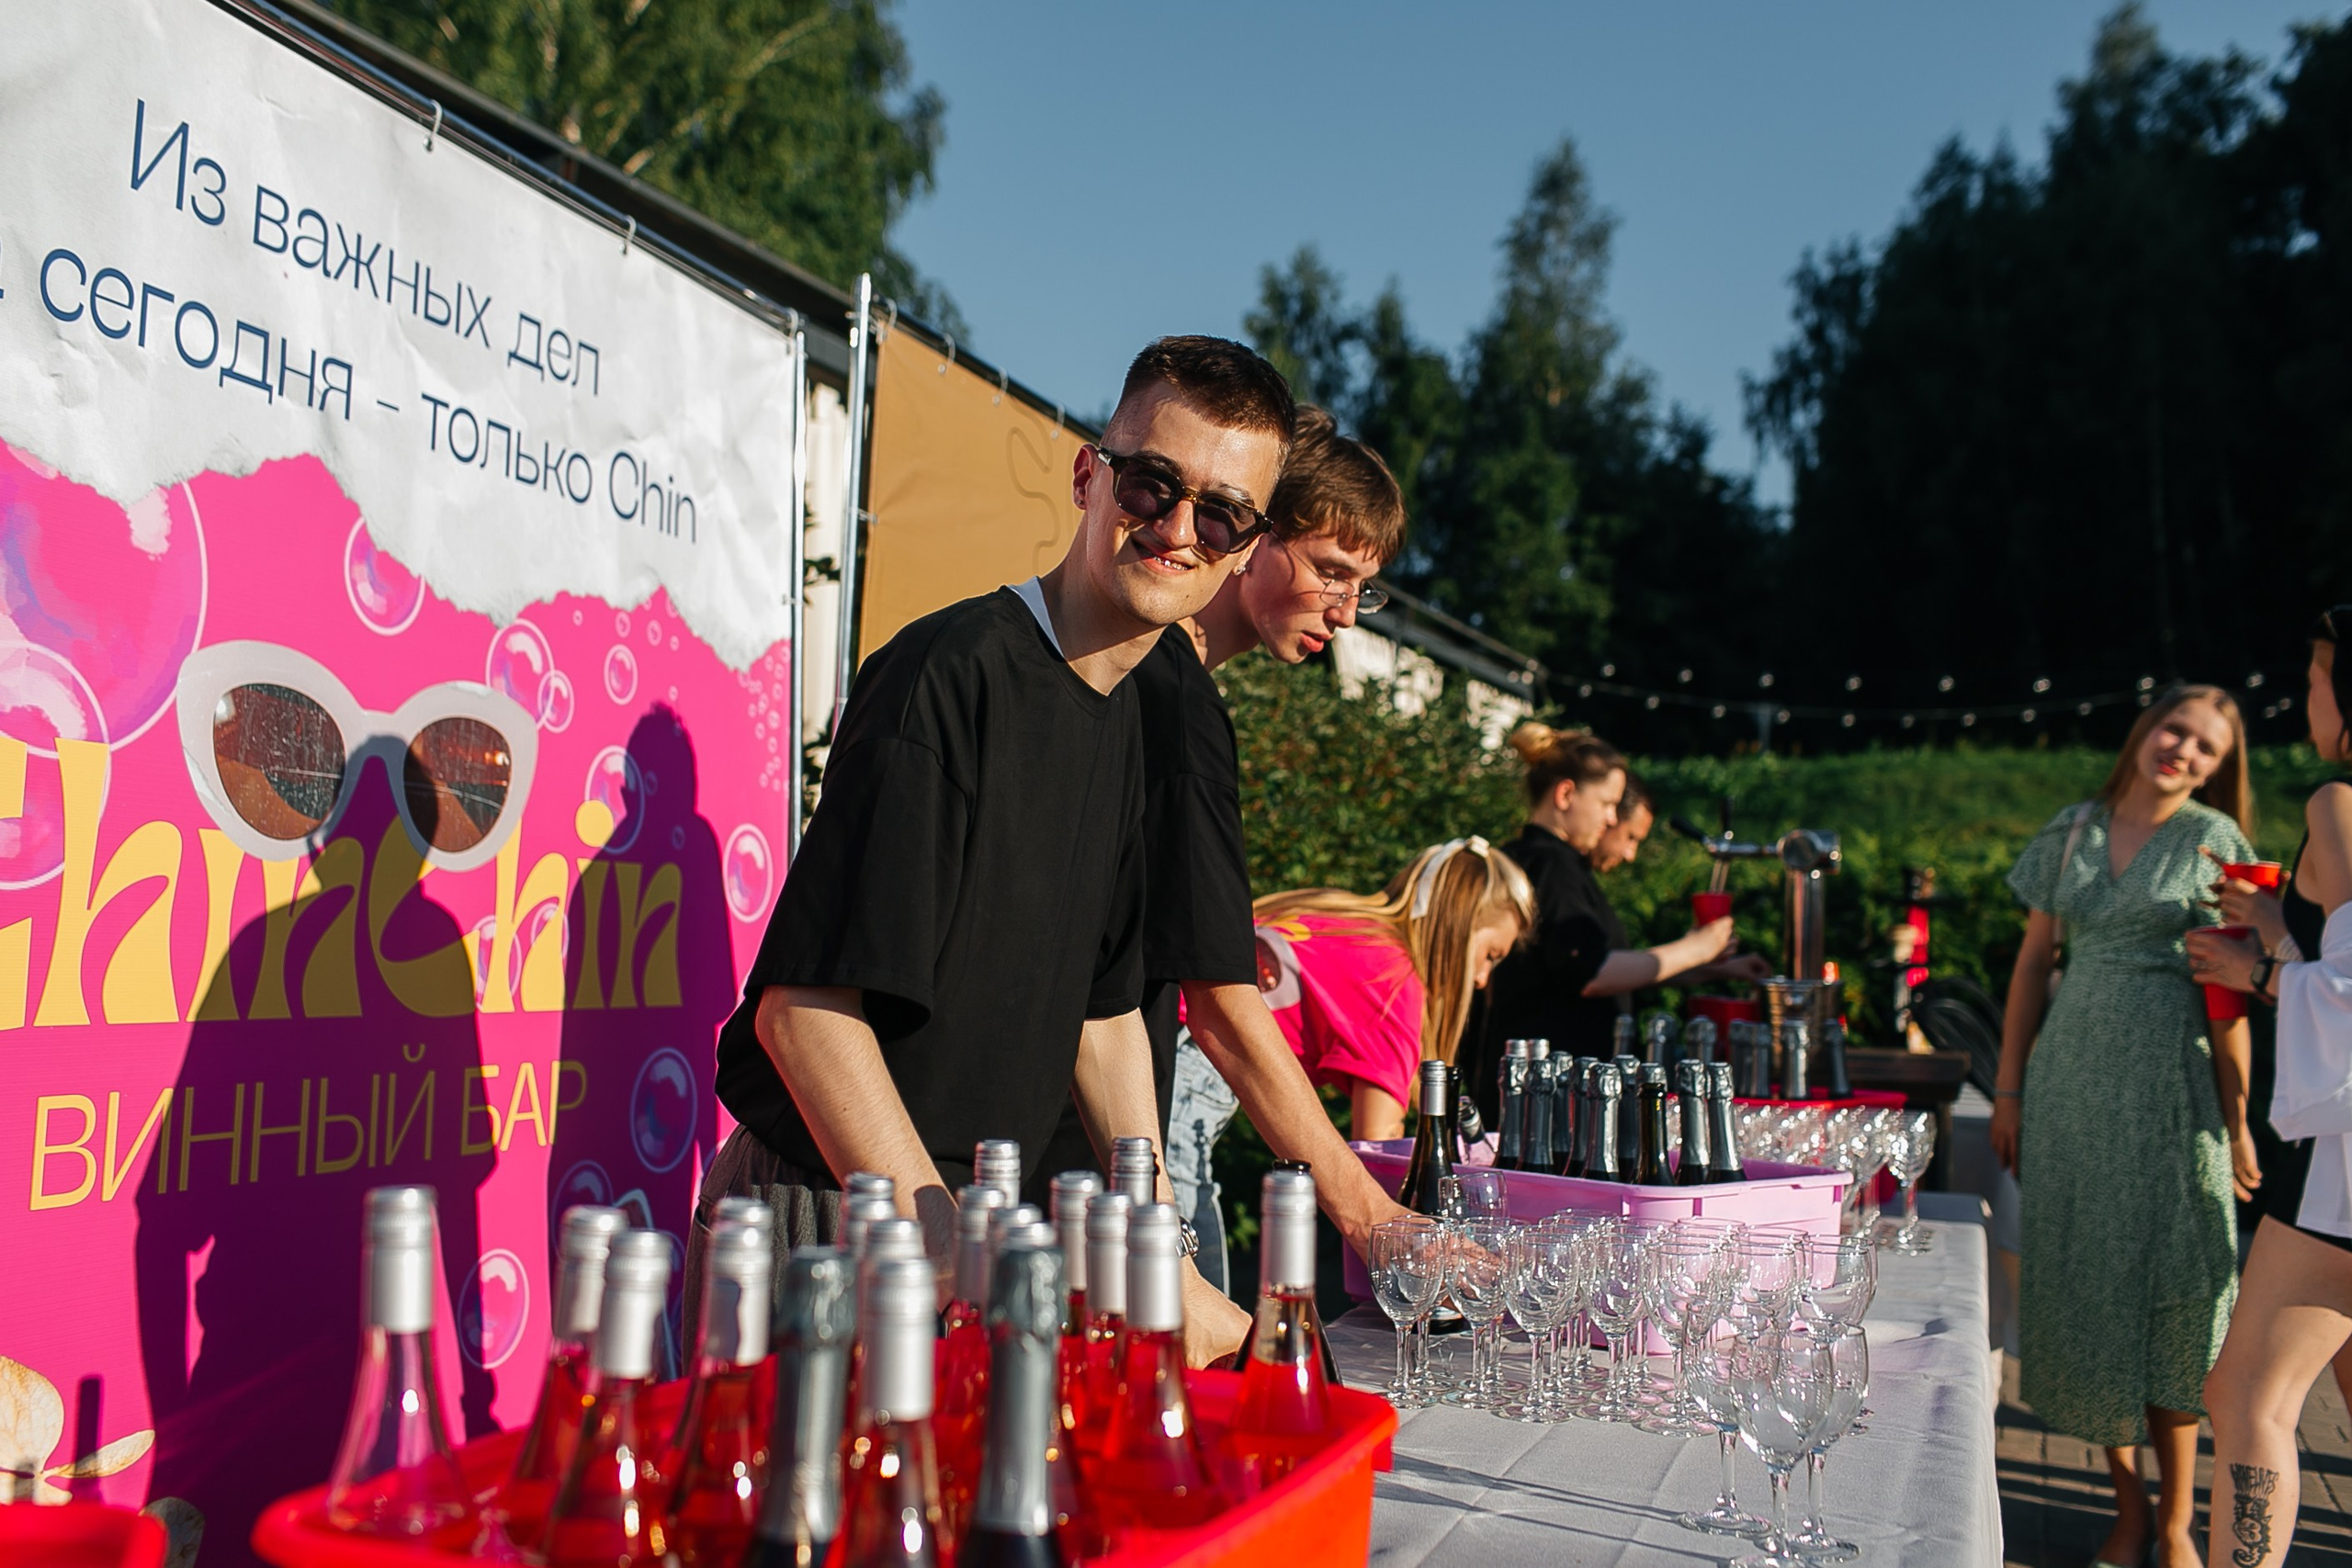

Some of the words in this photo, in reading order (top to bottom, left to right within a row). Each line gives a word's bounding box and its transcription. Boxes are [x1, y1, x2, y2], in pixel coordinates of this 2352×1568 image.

[131, 100, 227, 227] Из
[253, 185, 492, 348] важных
[508, 312, 601, 396] дел
[40, 248, 353, 421] сегодня
[421, 392, 593, 504] только
[608, 451, 696, 544] Chin
[0, 736, 684, 1031] hinChin
[28, 1043, 436, 1212] ВИННЫЙ
[460, 1059, 588, 1156] БАР
